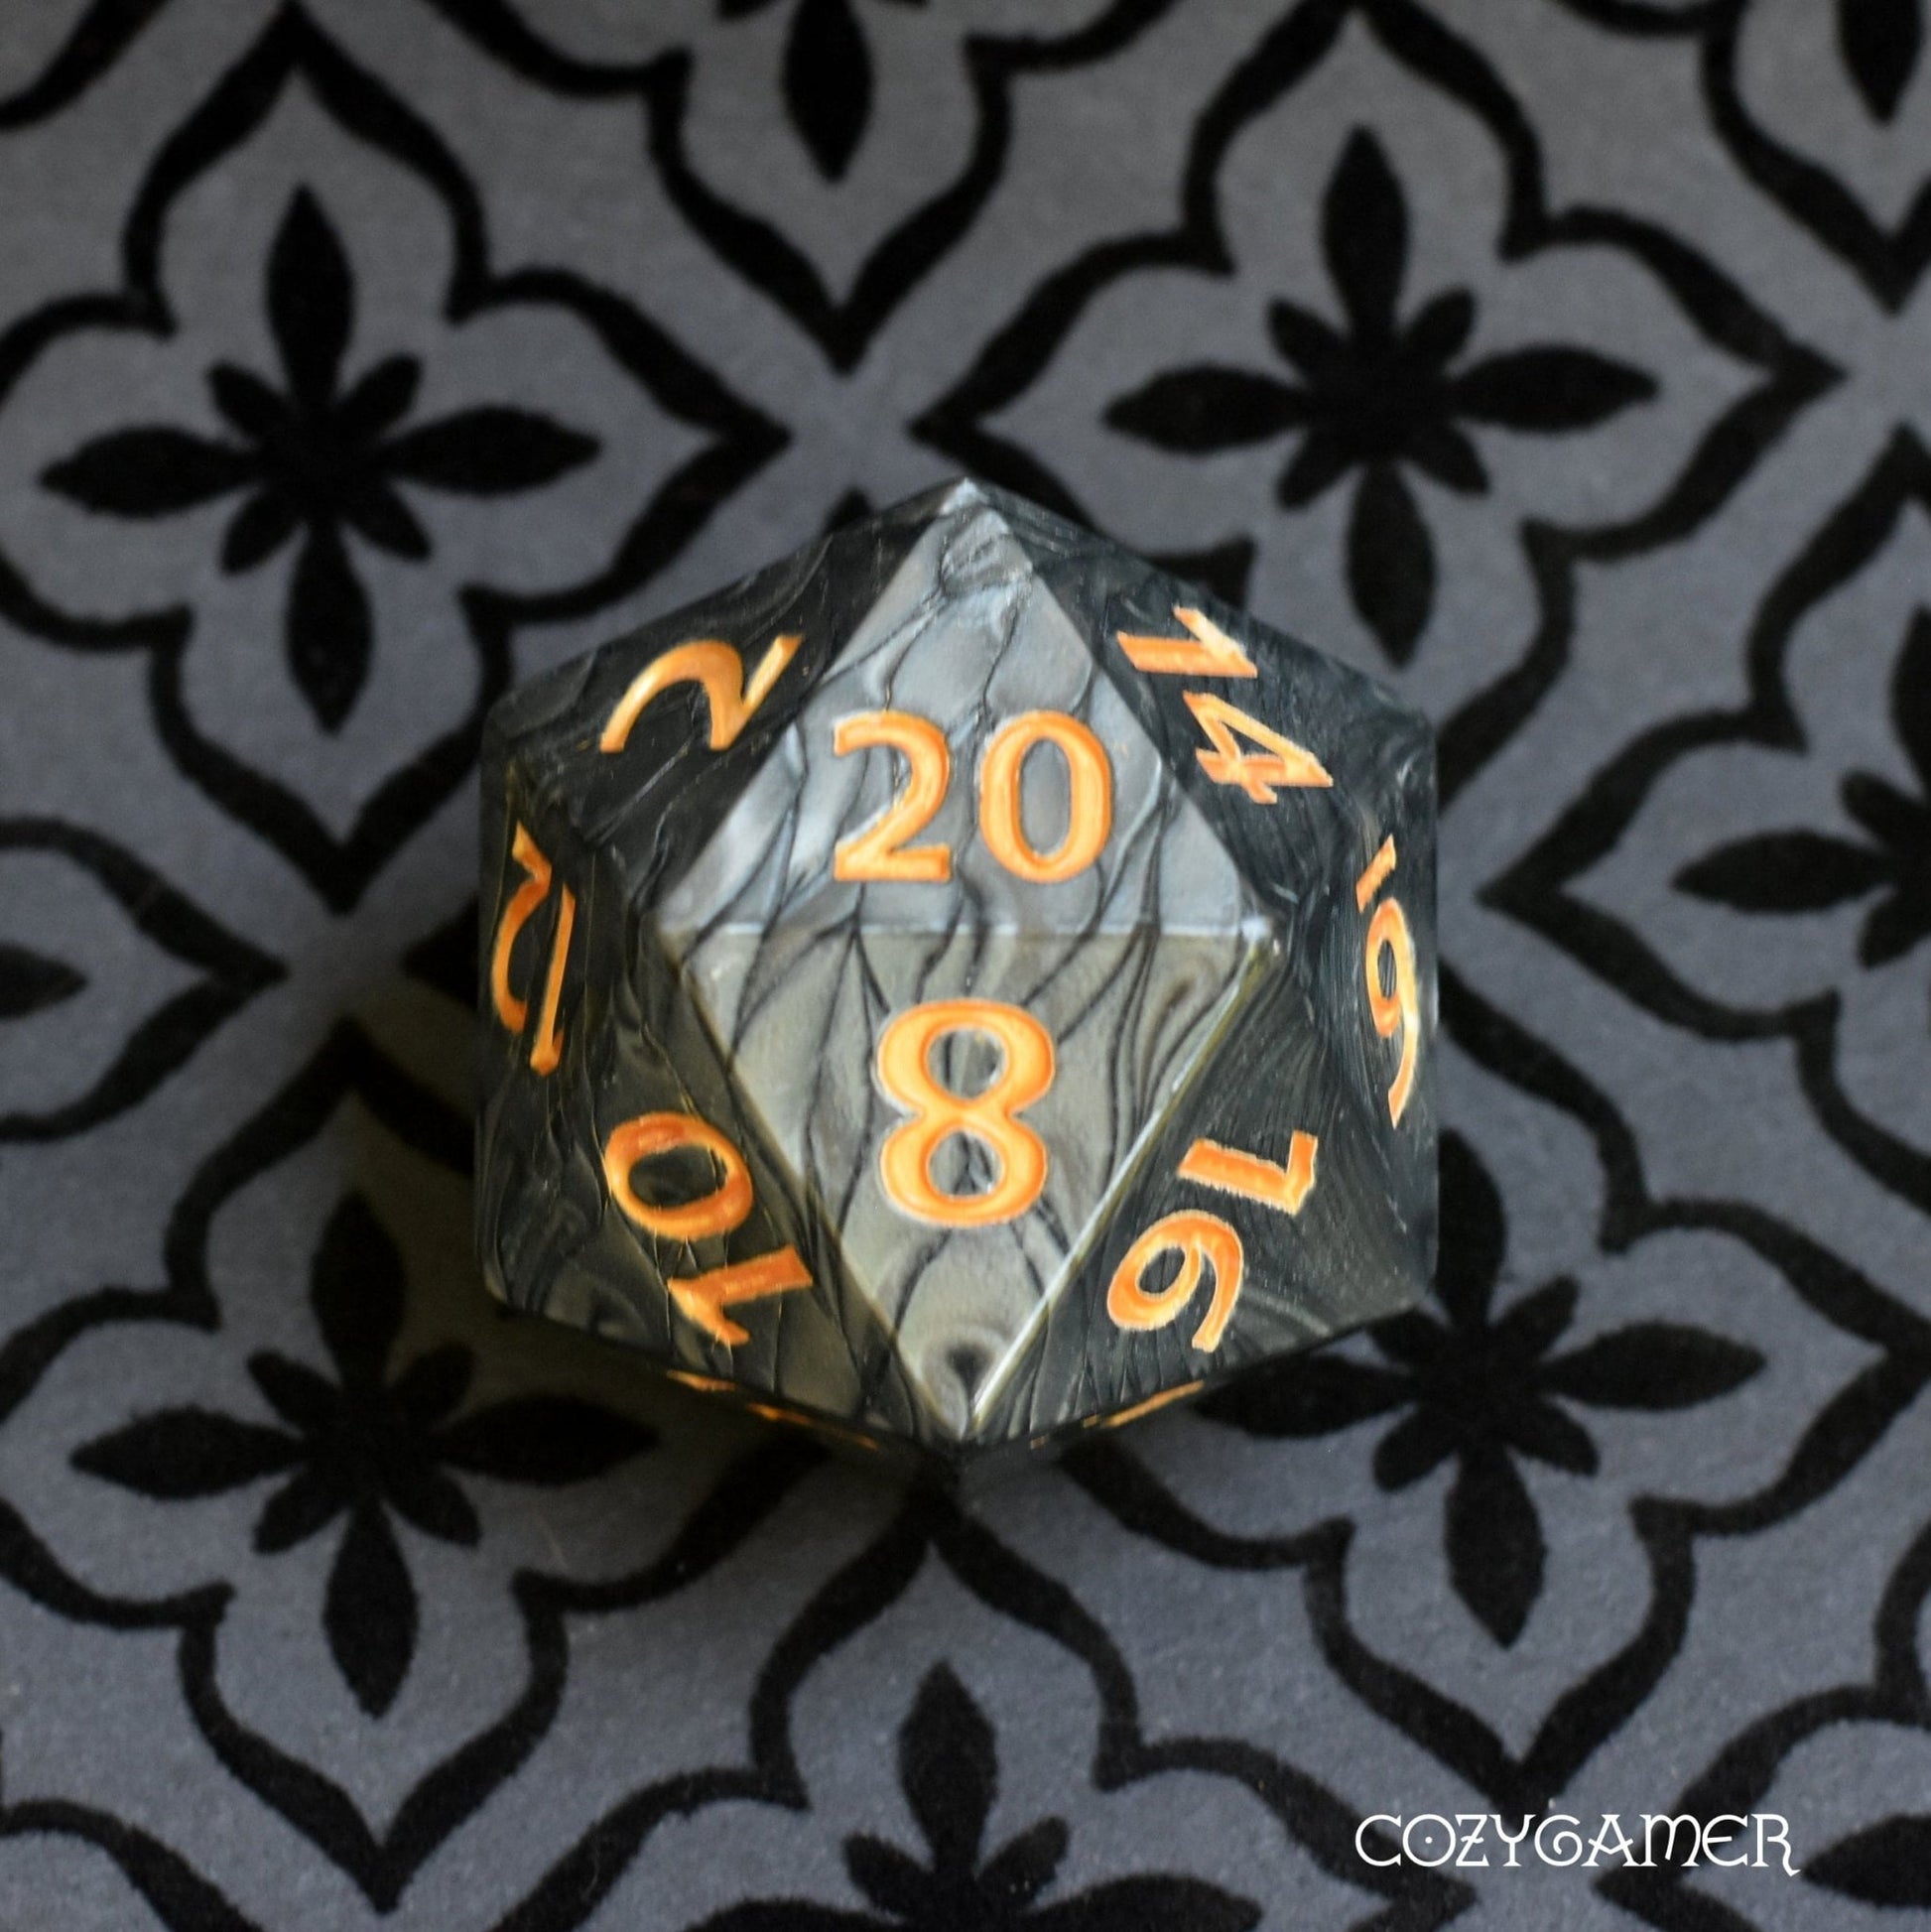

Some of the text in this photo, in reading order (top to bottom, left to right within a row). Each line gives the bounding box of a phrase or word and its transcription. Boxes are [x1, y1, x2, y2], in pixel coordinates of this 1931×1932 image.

[598, 633, 803, 753] 2
[832, 708, 1113, 884] 20
[1116, 604, 1335, 805] 14
[876, 997, 1058, 1228] 8
[600, 1110, 814, 1348] 10
[1106, 1129, 1320, 1352] 16
